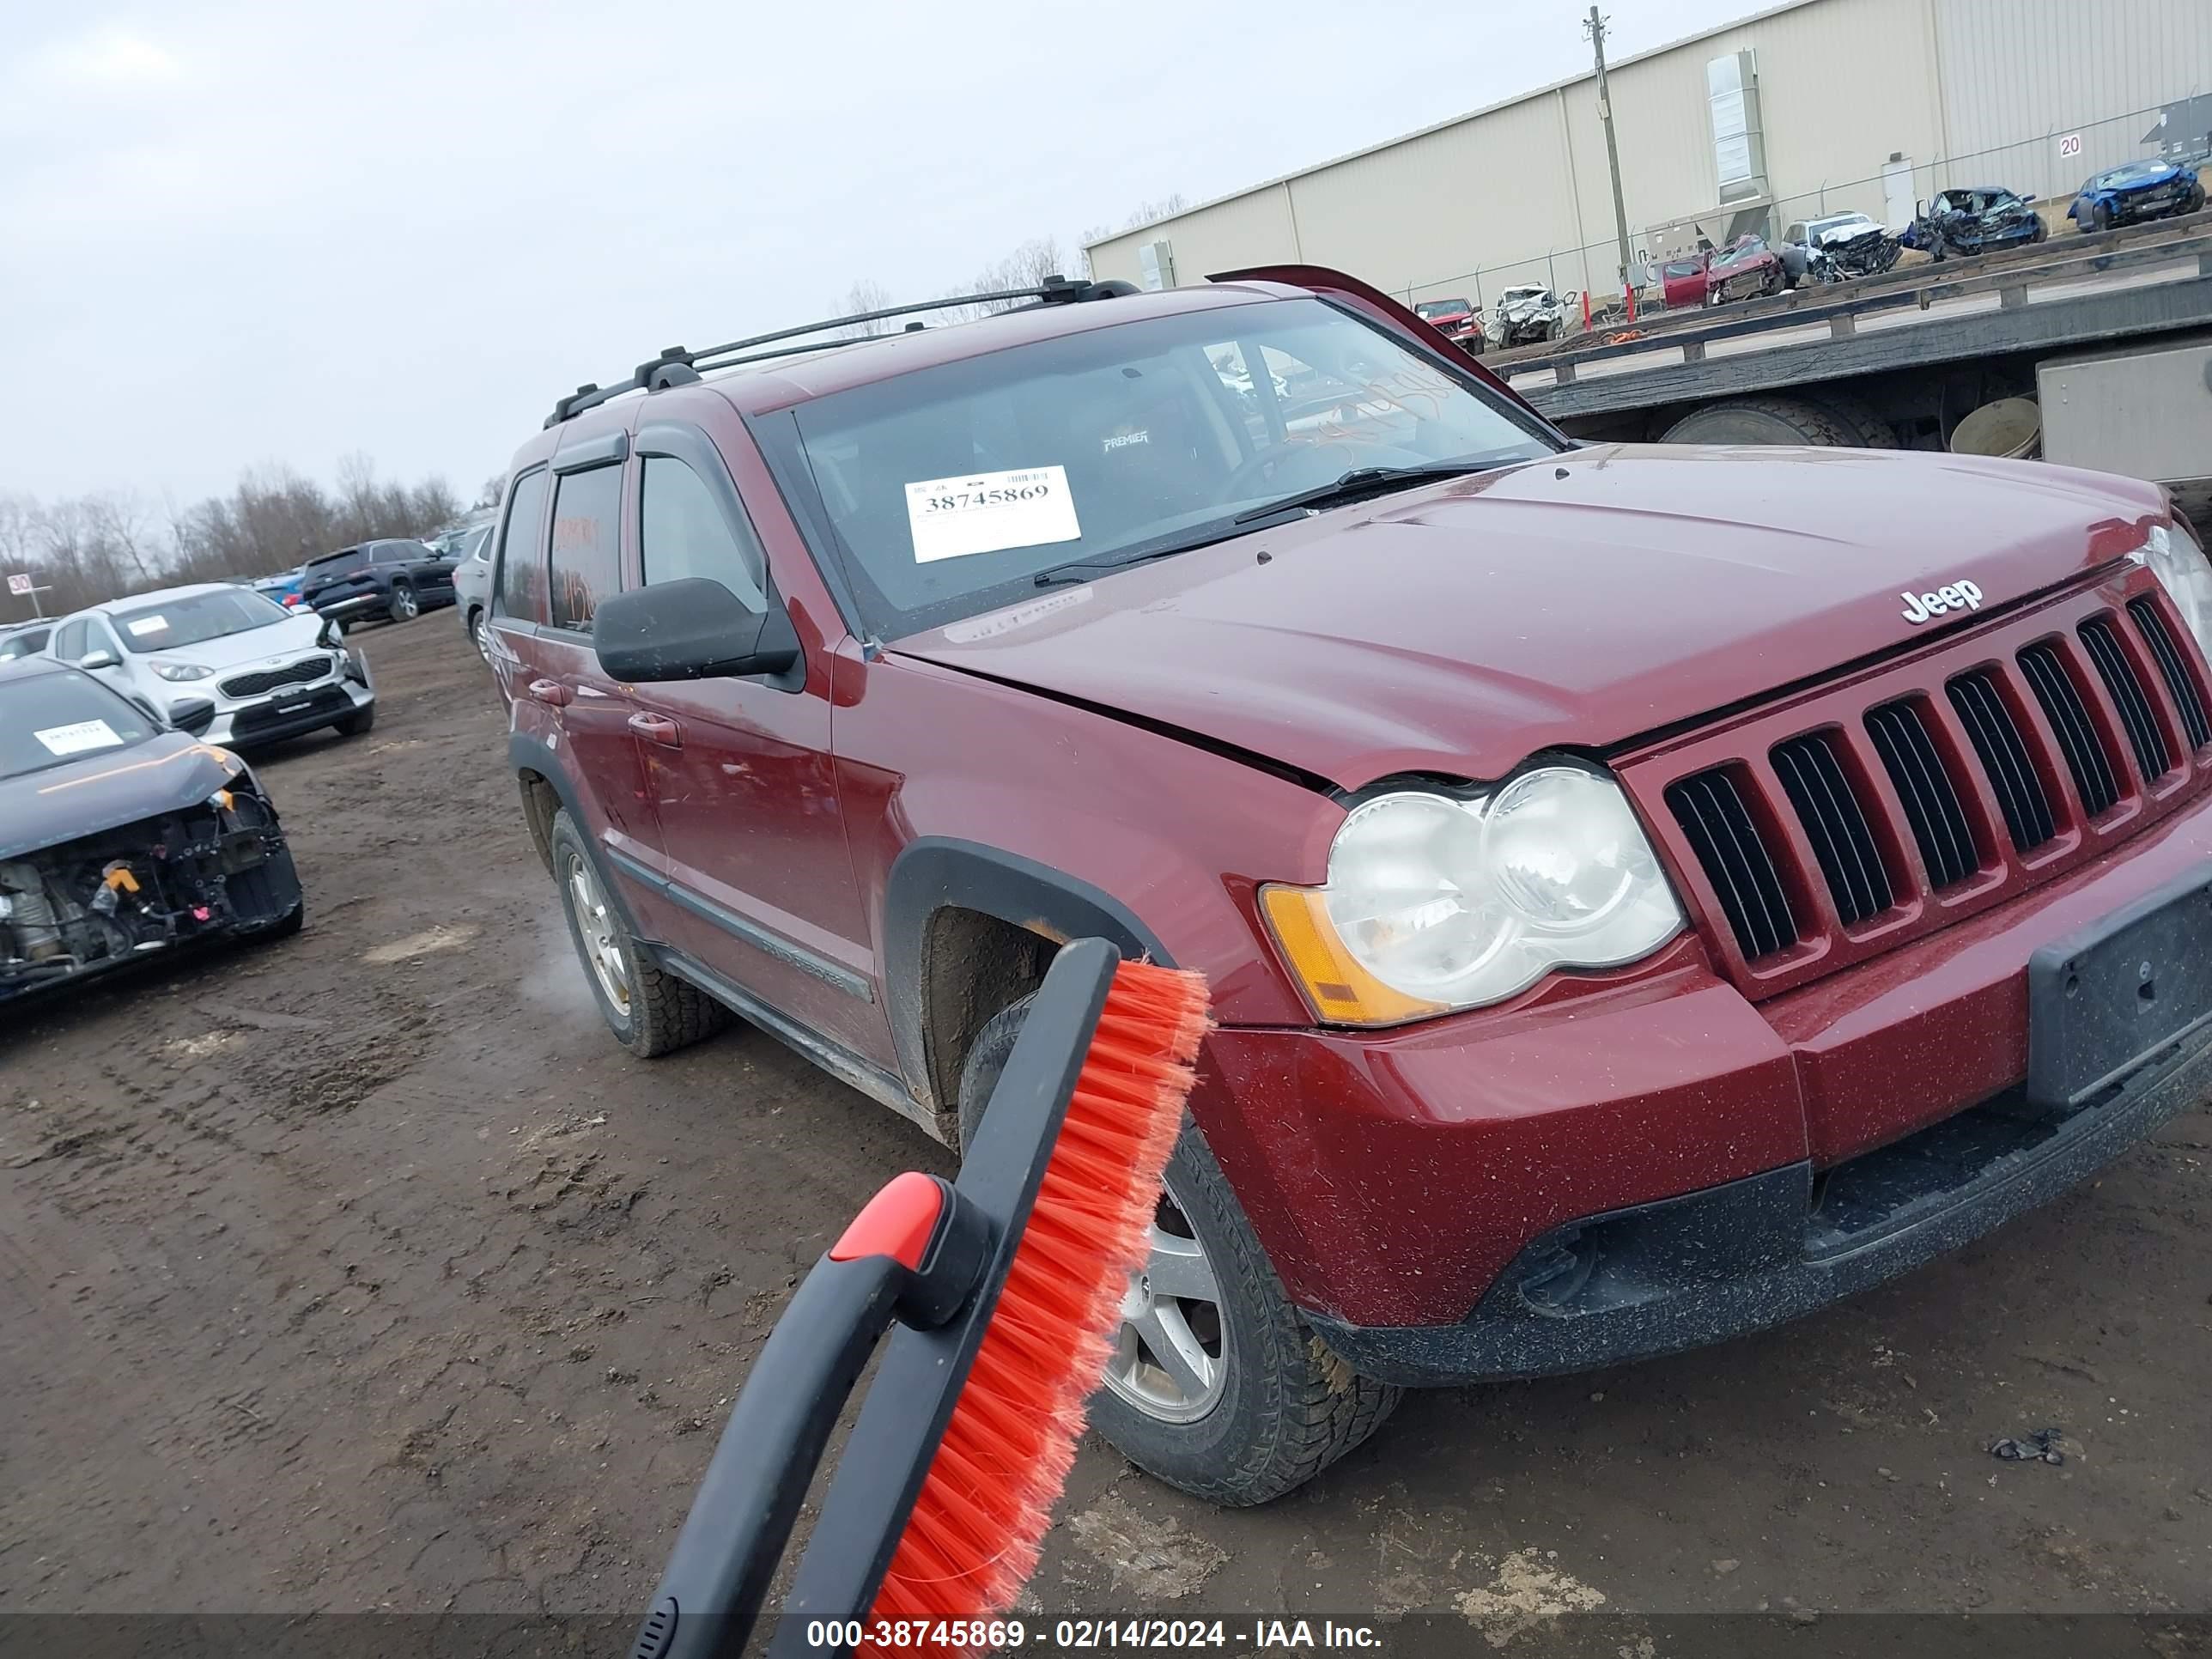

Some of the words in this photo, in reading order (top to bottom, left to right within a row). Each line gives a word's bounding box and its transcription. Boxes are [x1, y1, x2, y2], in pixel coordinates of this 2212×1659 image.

[2061, 137, 2080, 155] 20
[1103, 430, 1148, 453] PREMIER
[925, 484, 1049, 513] 38745869
[1900, 579, 1984, 625] Jeep
